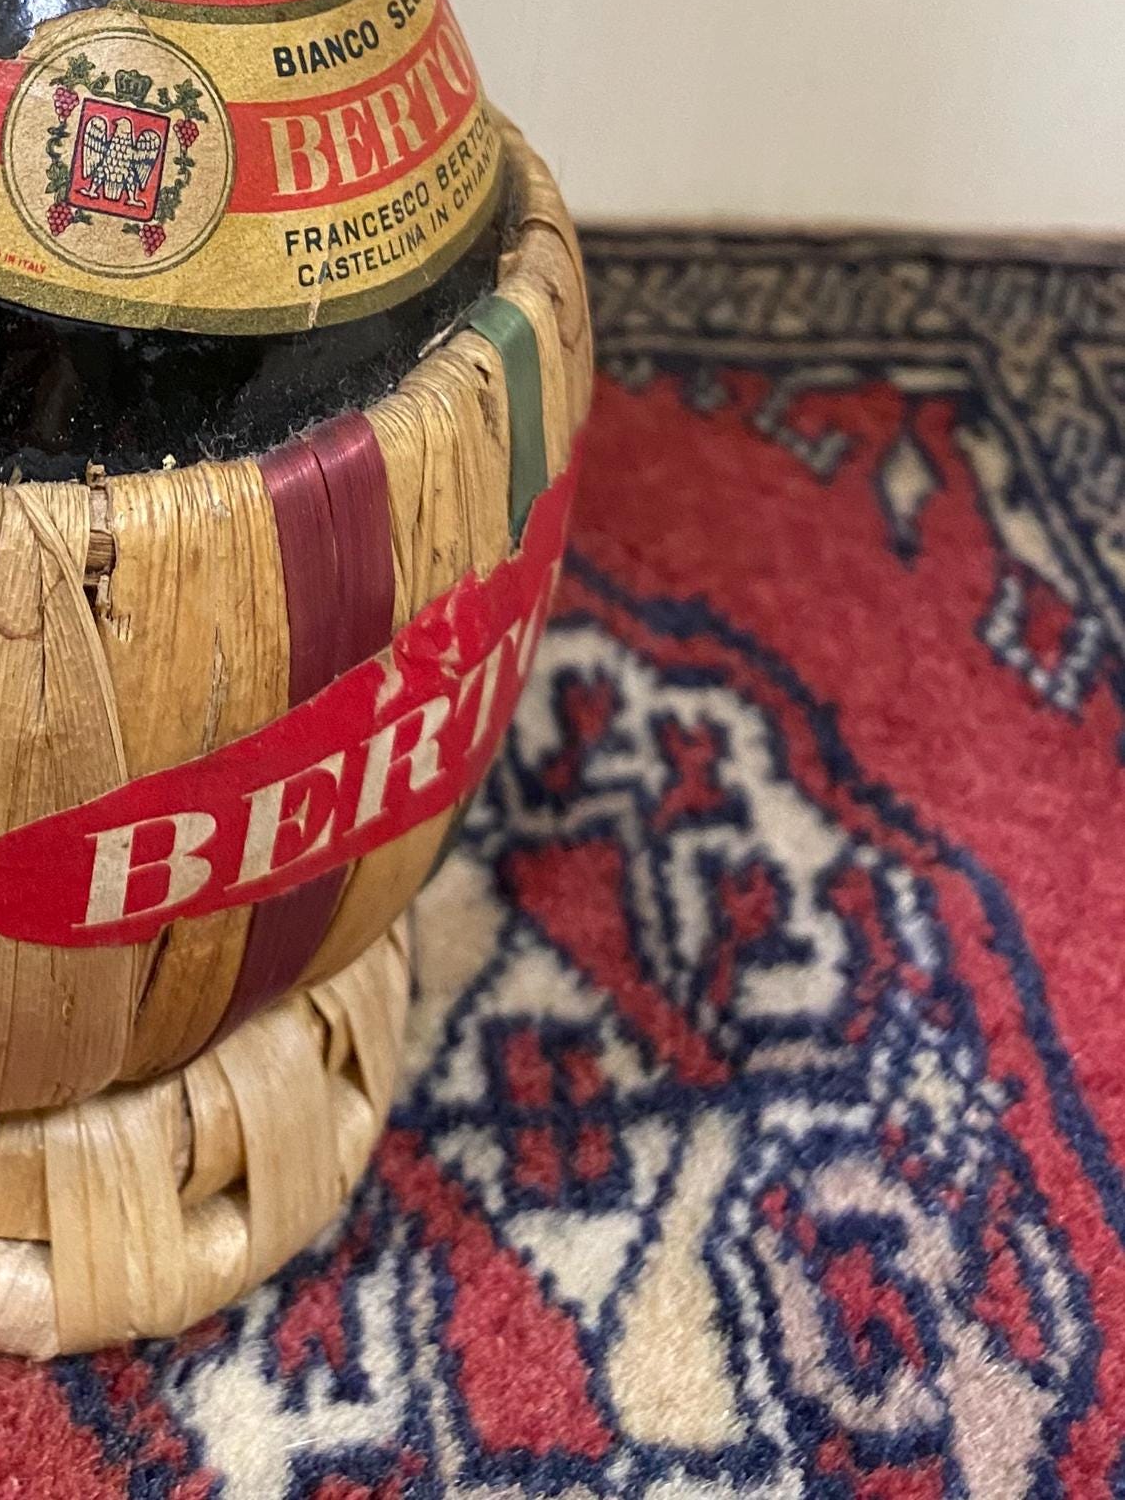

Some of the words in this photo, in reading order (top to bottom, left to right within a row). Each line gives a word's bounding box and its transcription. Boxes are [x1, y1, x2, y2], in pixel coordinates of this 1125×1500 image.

[272, 20, 380, 77] BIANCO
[284, 180, 430, 257] FRANCESCO
[298, 223, 426, 288] CASTELLINA
[430, 204, 450, 234] IN
[3, 253, 16, 265] IN
[18, 259, 47, 274] ITALY
